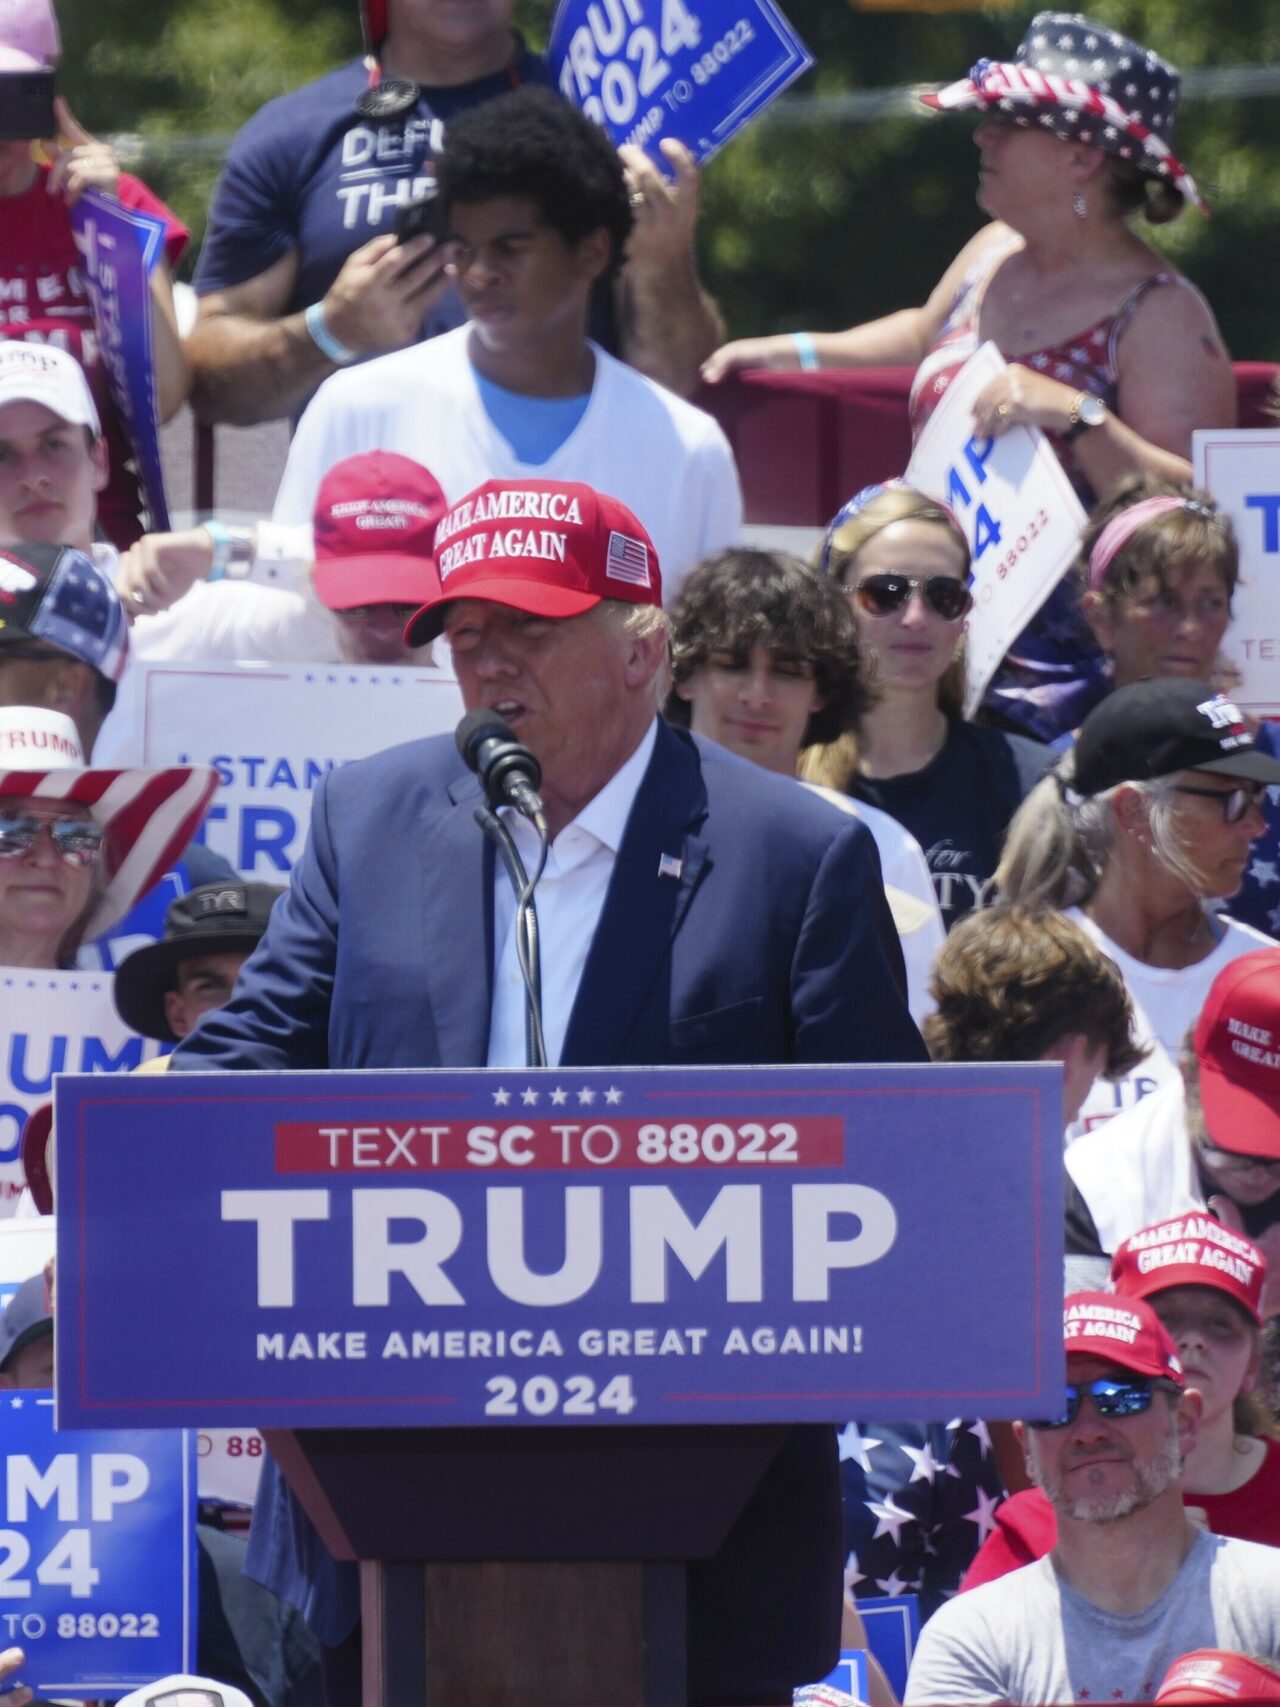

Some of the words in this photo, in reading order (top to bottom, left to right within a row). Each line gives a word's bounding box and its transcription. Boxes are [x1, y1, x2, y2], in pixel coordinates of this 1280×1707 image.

[558, 0, 644, 100] TRU
[661, 79, 694, 112] TO
[690, 18, 758, 86] 88022
[473, 490, 584, 525] AMERICA
[439, 533, 488, 582] GREAT
[488, 528, 568, 564] AGAIN
[209, 753, 360, 791] STAN
[1227, 1017, 1273, 1046] MAKE
[319, 1127, 450, 1166] TEXT
[466, 1125, 535, 1166] SC
[550, 1124, 620, 1164] TO
[636, 1122, 798, 1163] 88022
[221, 1183, 898, 1307] TRUMP
[1127, 1221, 1183, 1253] MAKE
[1184, 1217, 1264, 1268] AMERICA
[1138, 1242, 1200, 1275] GREAT
[1200, 1245, 1256, 1286] AGAIN
[1068, 1304, 1142, 1331] AMERICA
[1083, 1321, 1138, 1344] AGAIN
[256, 1332, 368, 1360] MAKE
[382, 1329, 564, 1359] AMERICA
[578, 1328, 708, 1356] GREAT
[723, 1326, 864, 1355] AGAIN!
[484, 1375, 637, 1416] 2024
[2, 1613, 46, 1639] TO
[57, 1613, 160, 1639] 88022
